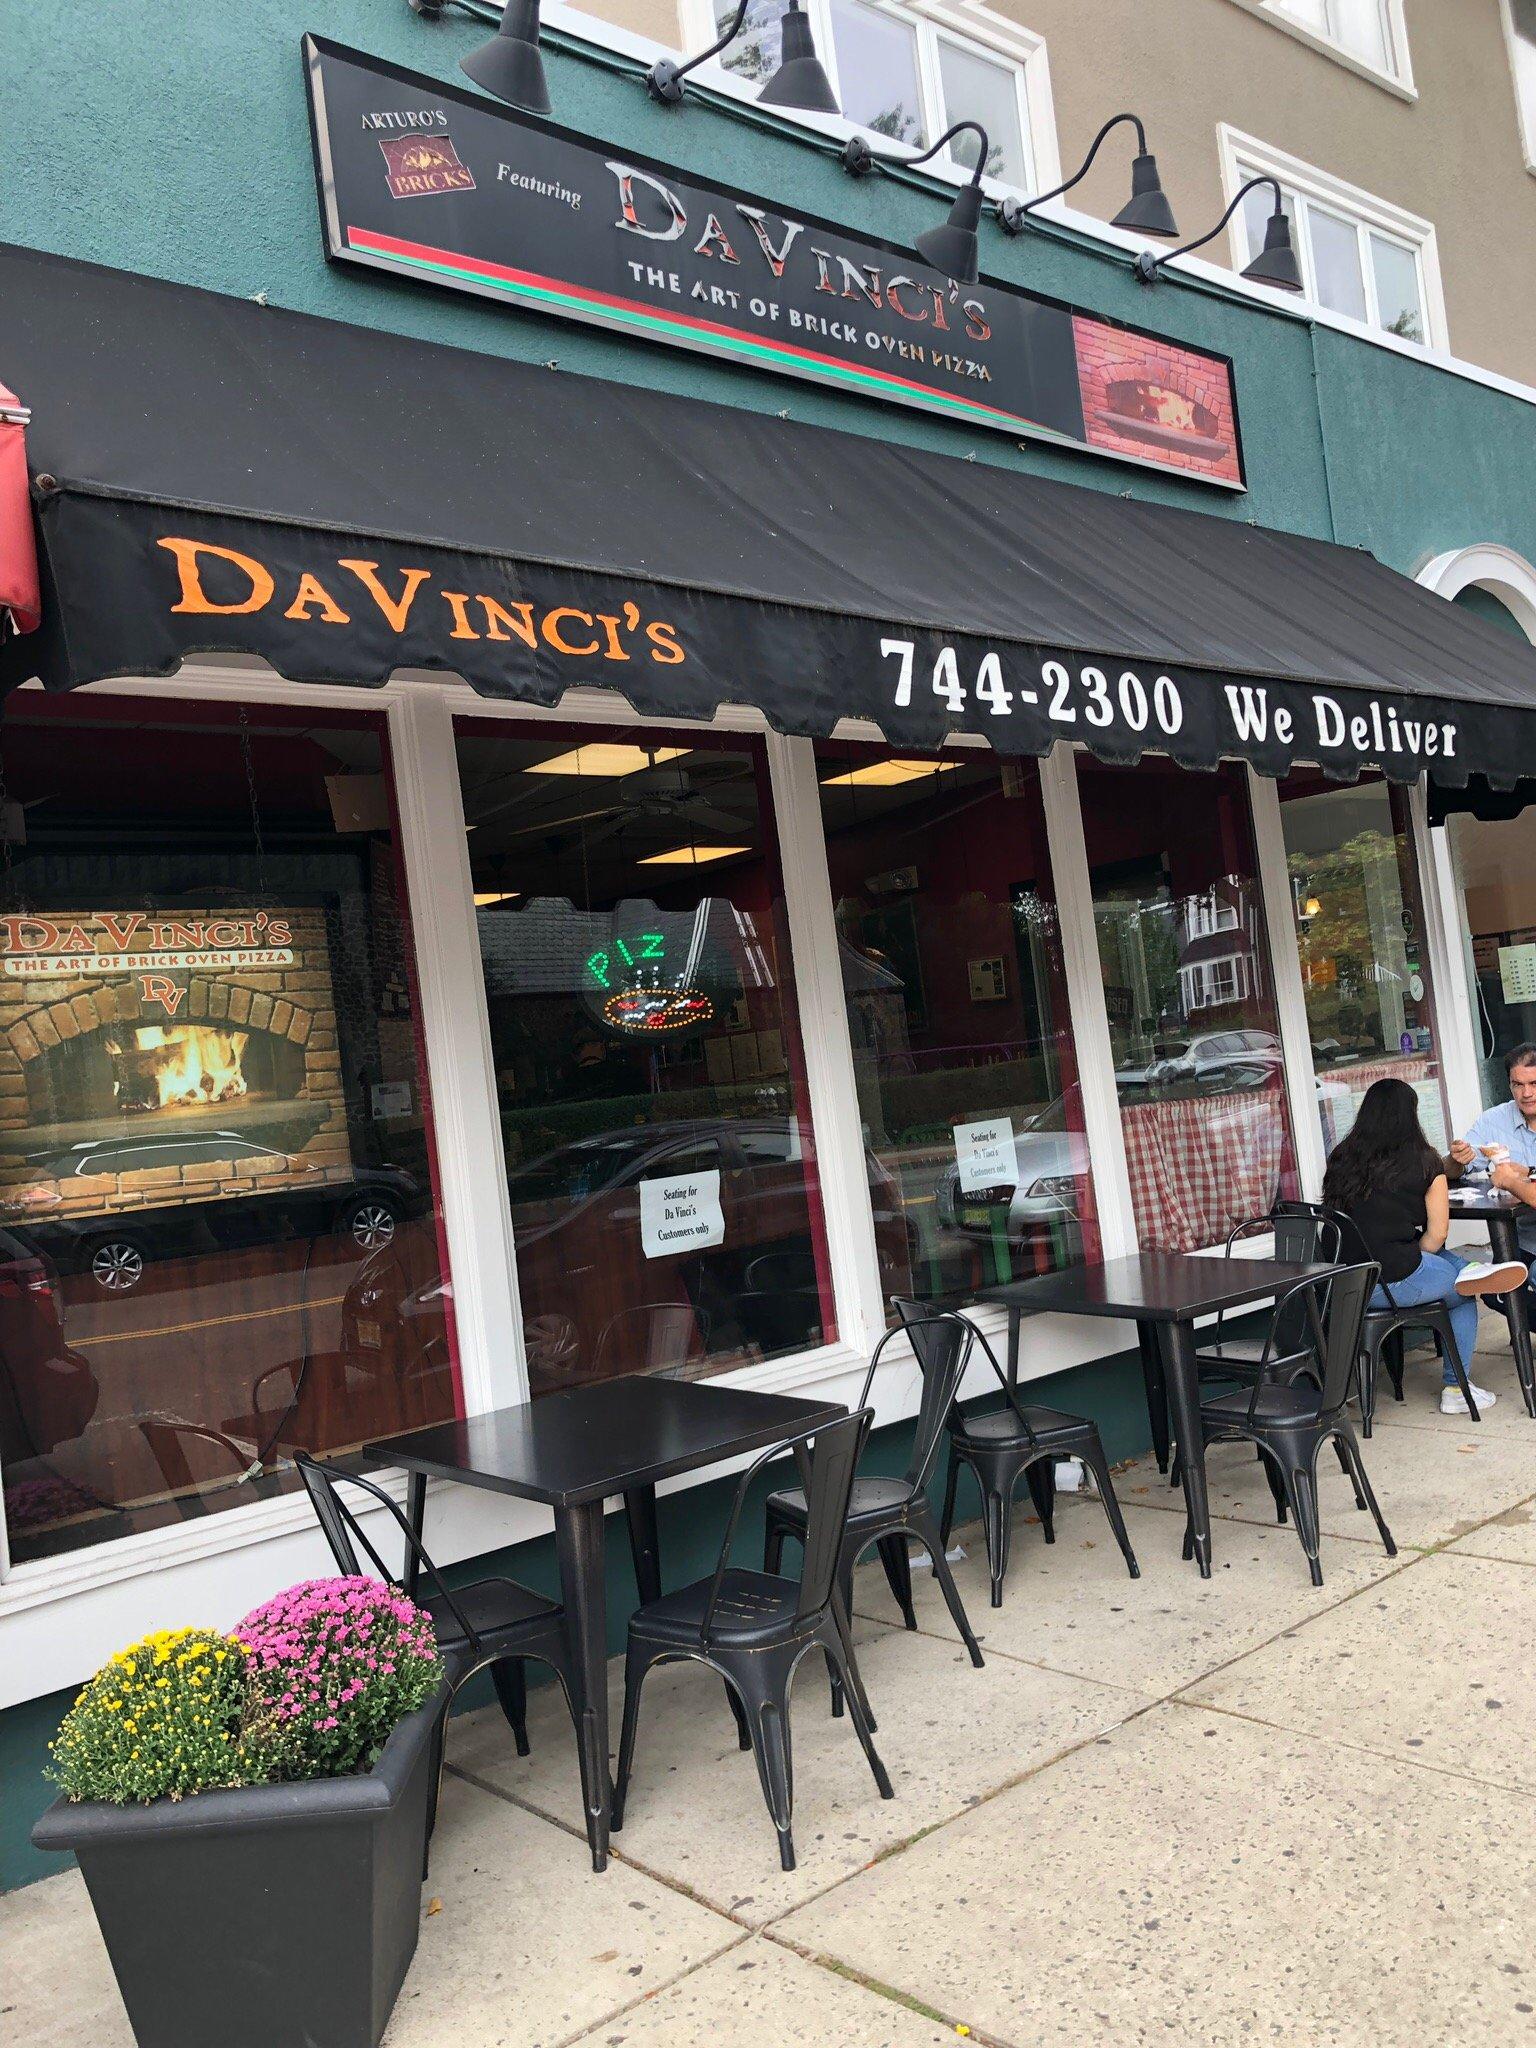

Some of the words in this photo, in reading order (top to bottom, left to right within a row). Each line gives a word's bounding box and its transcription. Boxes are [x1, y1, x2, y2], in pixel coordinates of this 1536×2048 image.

[361, 110, 448, 130] ARTURO'S
[394, 169, 471, 193] BRICKS
[496, 163, 583, 210] Featuring
[628, 261, 682, 294] THE
[691, 280, 740, 309] ART
[750, 298, 780, 321] OF
[790, 308, 858, 344] BRICK
[865, 331, 924, 363] OVEN
[932, 349, 993, 383] PIZZA
[880, 638, 1184, 736] 744-2300
[1224, 684, 1294, 745] We
[1312, 695, 1457, 757] Deliver
[11, 960, 49, 972] THE
[55, 958, 92, 971] ART
[97, 957, 120, 968] OF
[127, 955, 180, 967] BRICK
[185, 953, 232, 965] OVEN
[238, 952, 288, 963] PIZZA
[138, 974, 187, 1015] DV
[663, 1187, 687, 1201] Seating
[688, 1185, 698, 1197] for
[665, 1208, 674, 1220] Da
[675, 1204, 697, 1218] Vinci's
[658, 1226, 695, 1241] Customers
[695, 1222, 709, 1235] only
